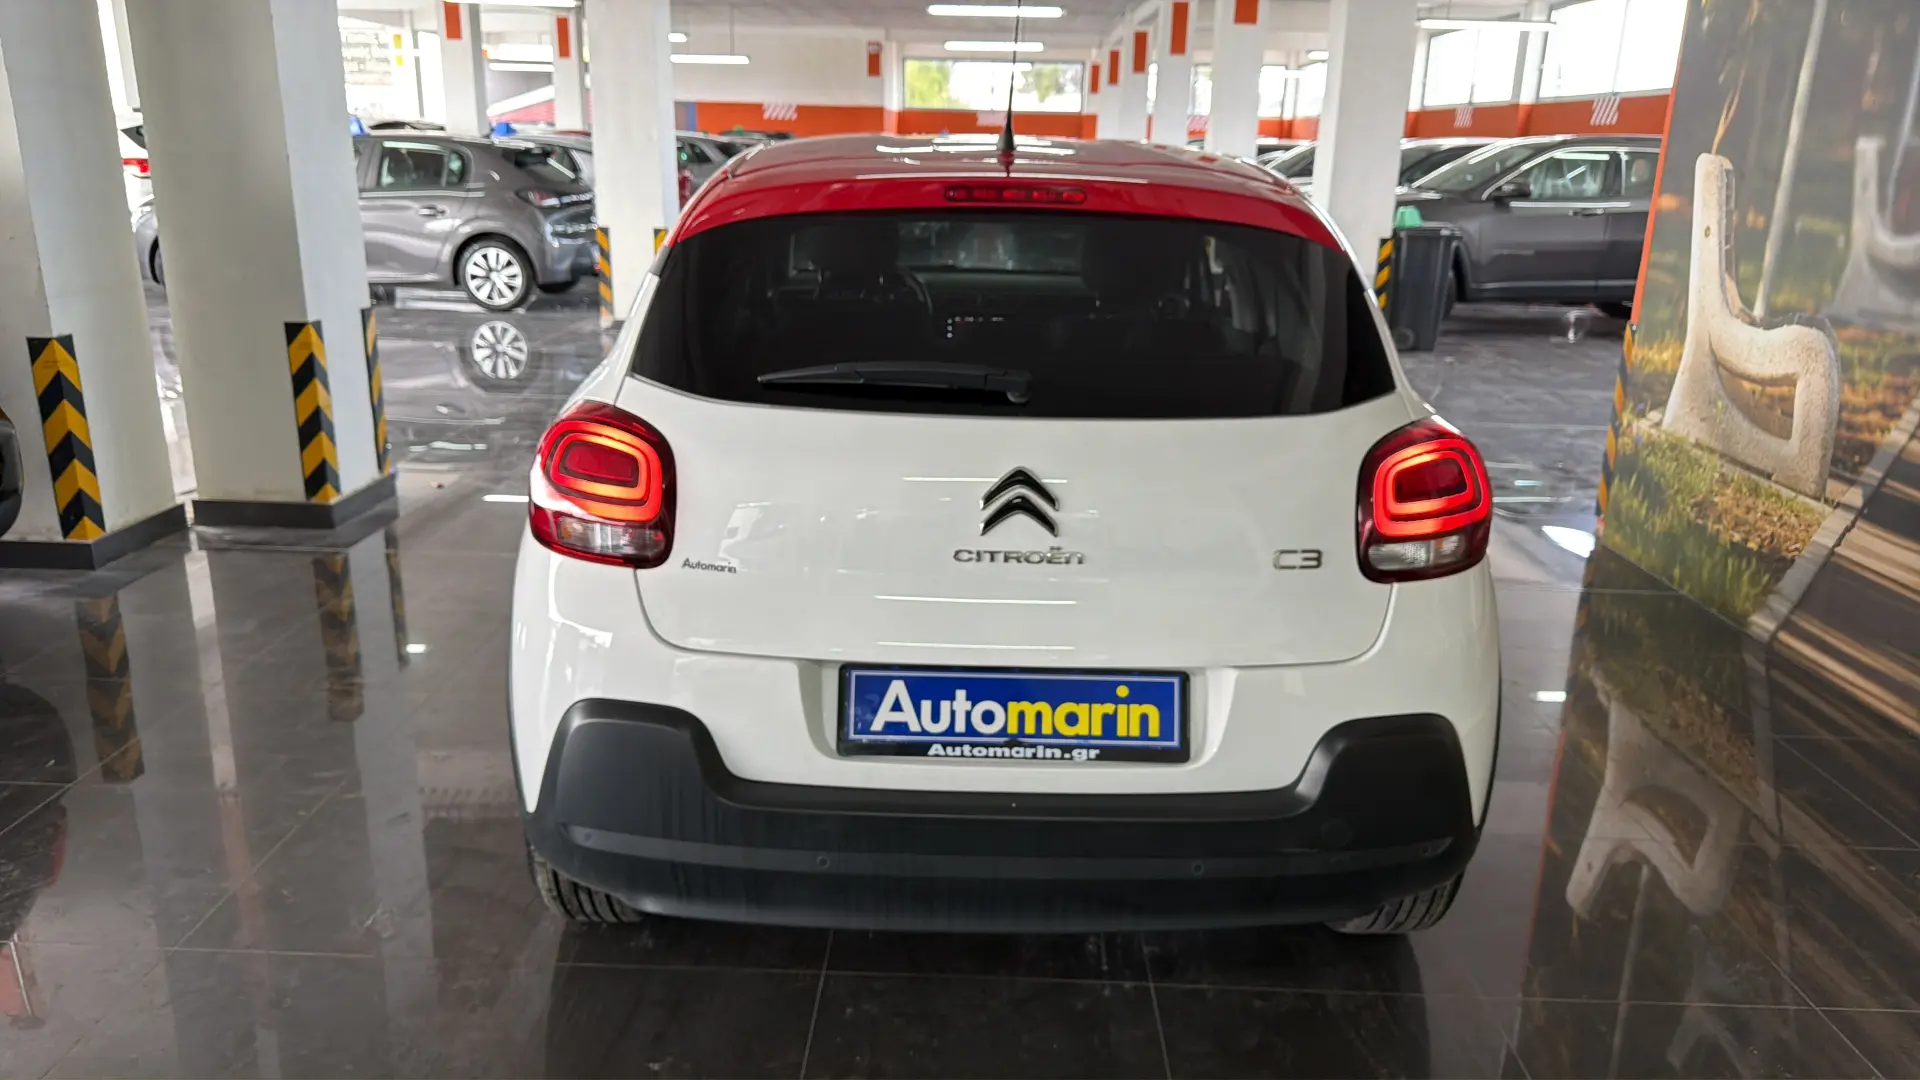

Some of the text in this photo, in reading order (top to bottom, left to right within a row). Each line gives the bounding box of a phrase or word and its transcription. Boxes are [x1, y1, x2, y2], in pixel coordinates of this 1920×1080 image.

[682, 557, 737, 574] Automarin
[1272, 549, 1323, 570] C3
[870, 680, 1161, 738] Automarin
[927, 743, 1100, 762] Automarin.gr
